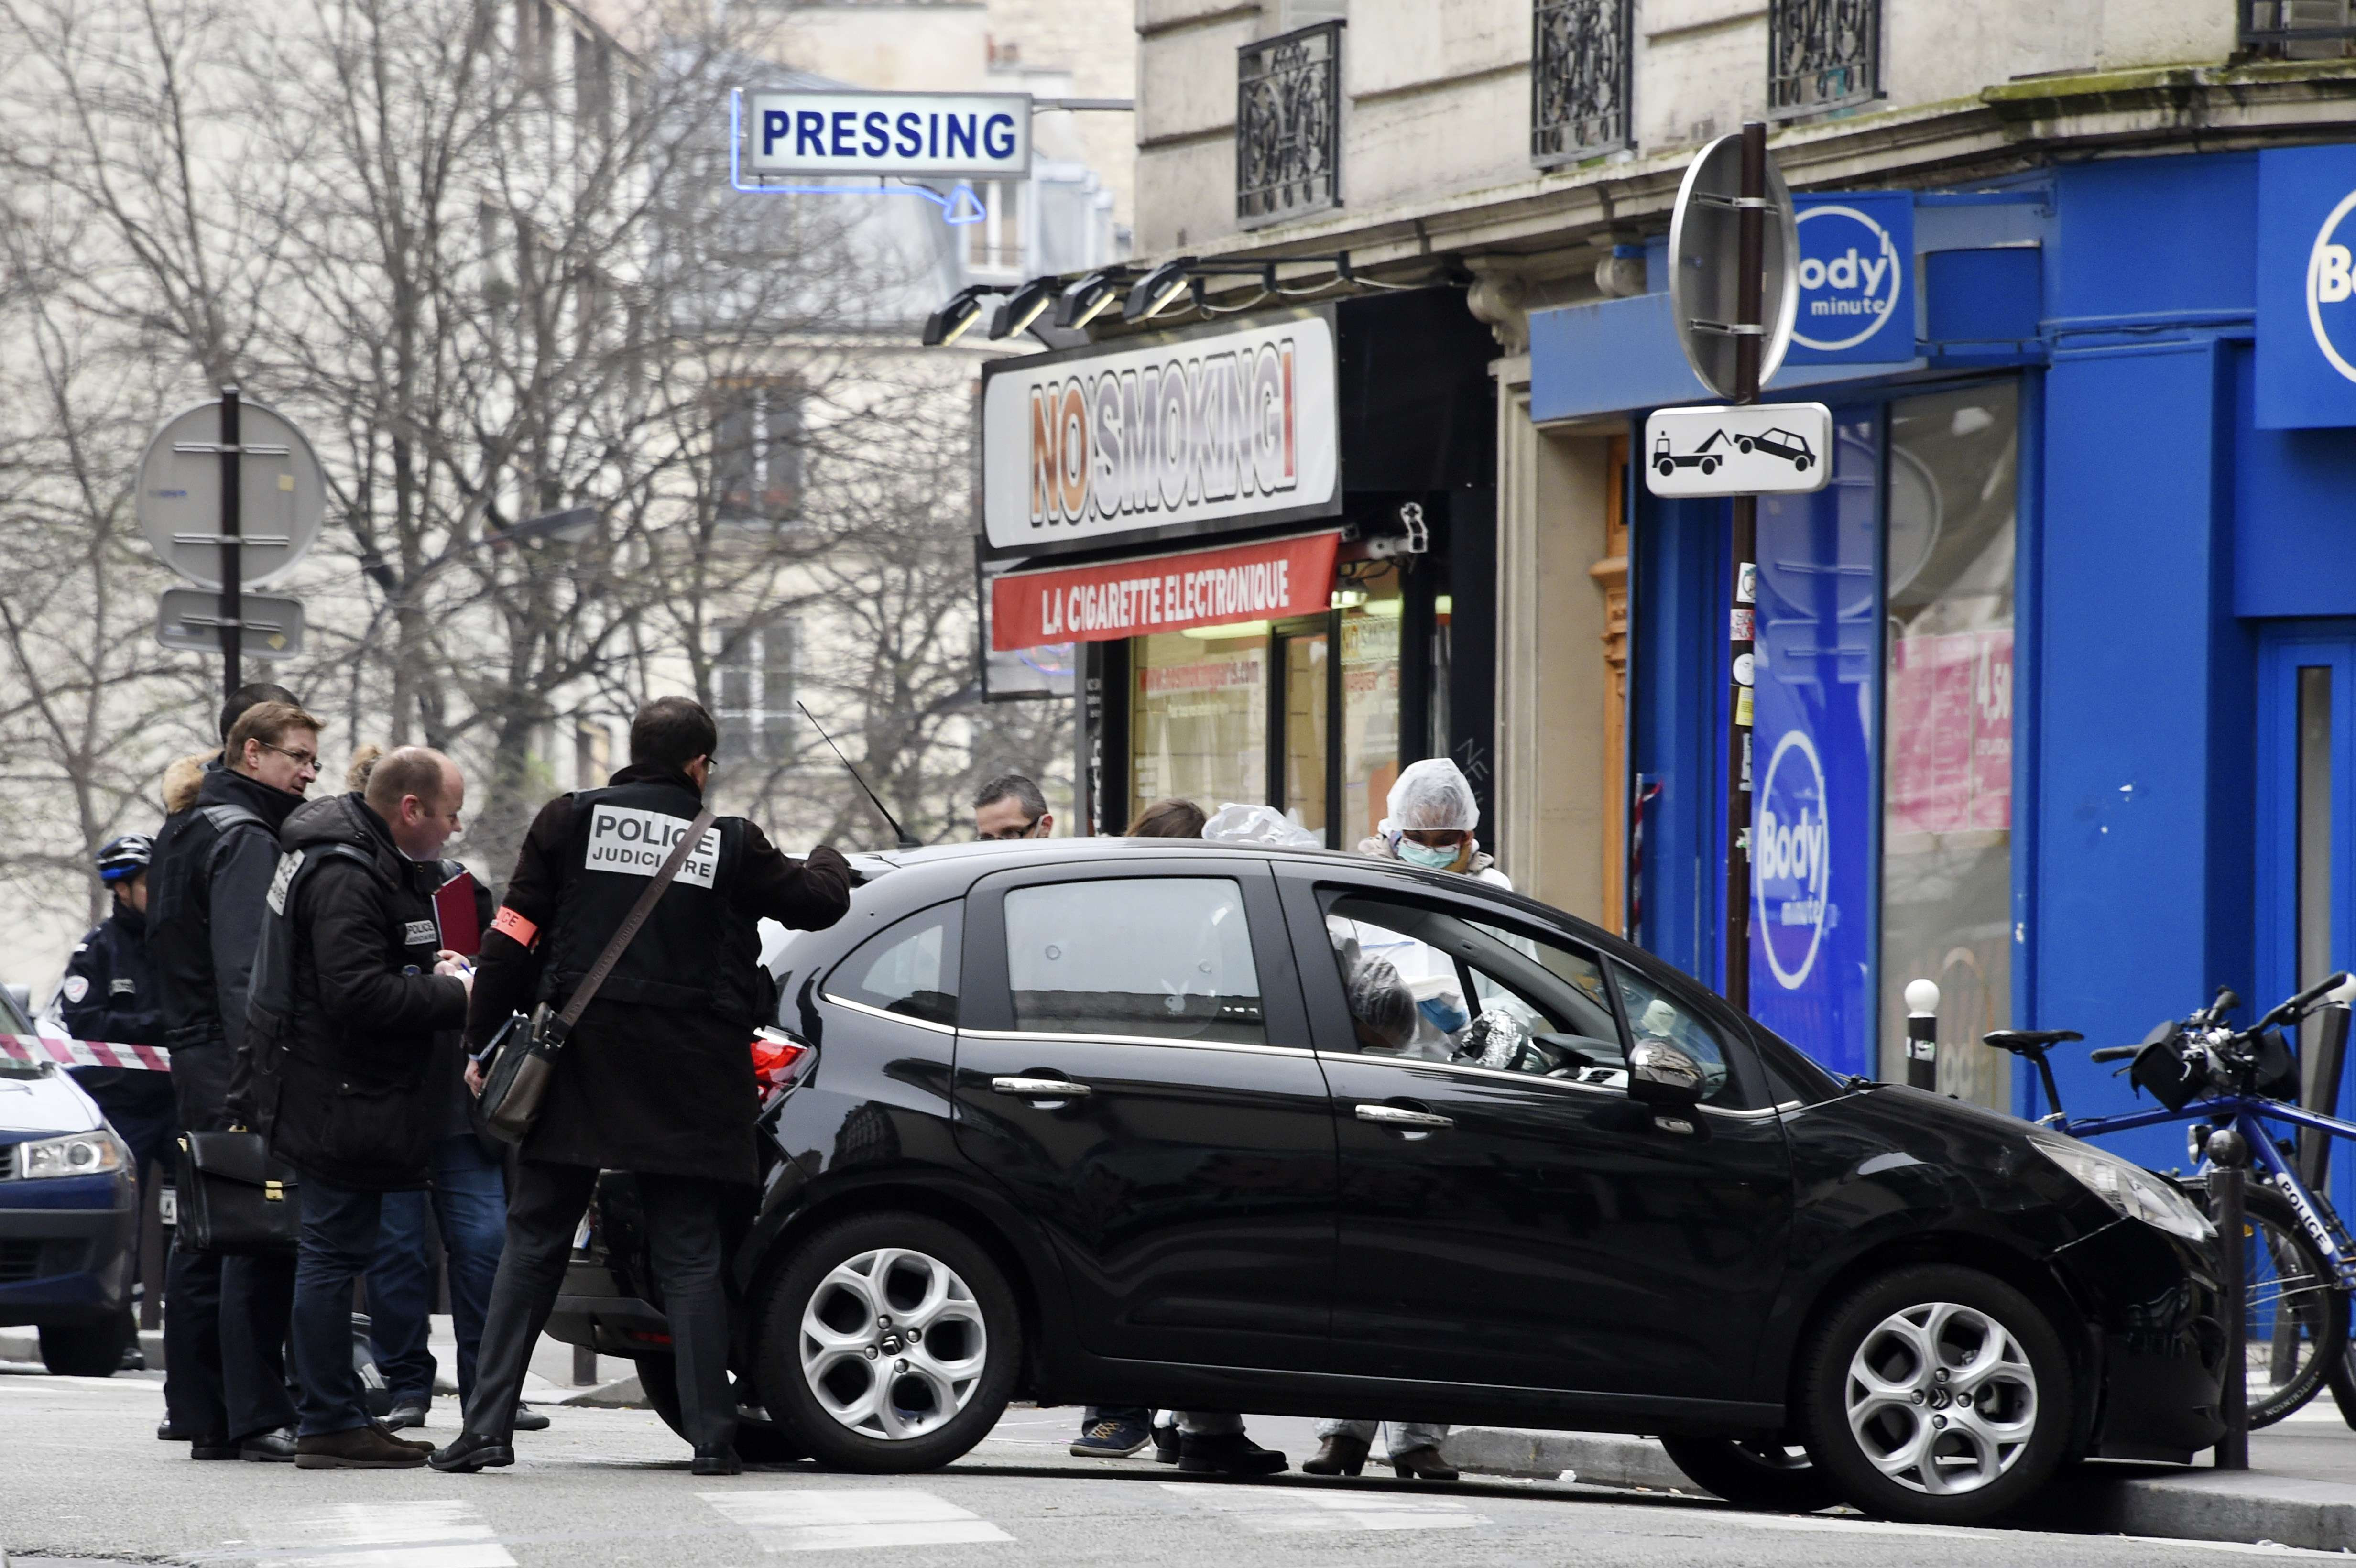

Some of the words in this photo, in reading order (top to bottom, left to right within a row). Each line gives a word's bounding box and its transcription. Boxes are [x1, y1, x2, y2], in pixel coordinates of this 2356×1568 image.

[763, 110, 1016, 159] PRESSING
[2319, 244, 2356, 303] B
[1811, 296, 1887, 316] minute
[1030, 375, 1090, 527] NO
[1042, 588, 1063, 635] LA
[1067, 577, 1161, 632] CIGARETTE
[1164, 559, 1289, 622] ELECTRONIQUE
[592, 847, 711, 878] JUDICIRE
[407, 922, 433, 936] POLICE
[501, 911, 519, 928] CE
[2282, 1181, 2328, 1247] POLICE
